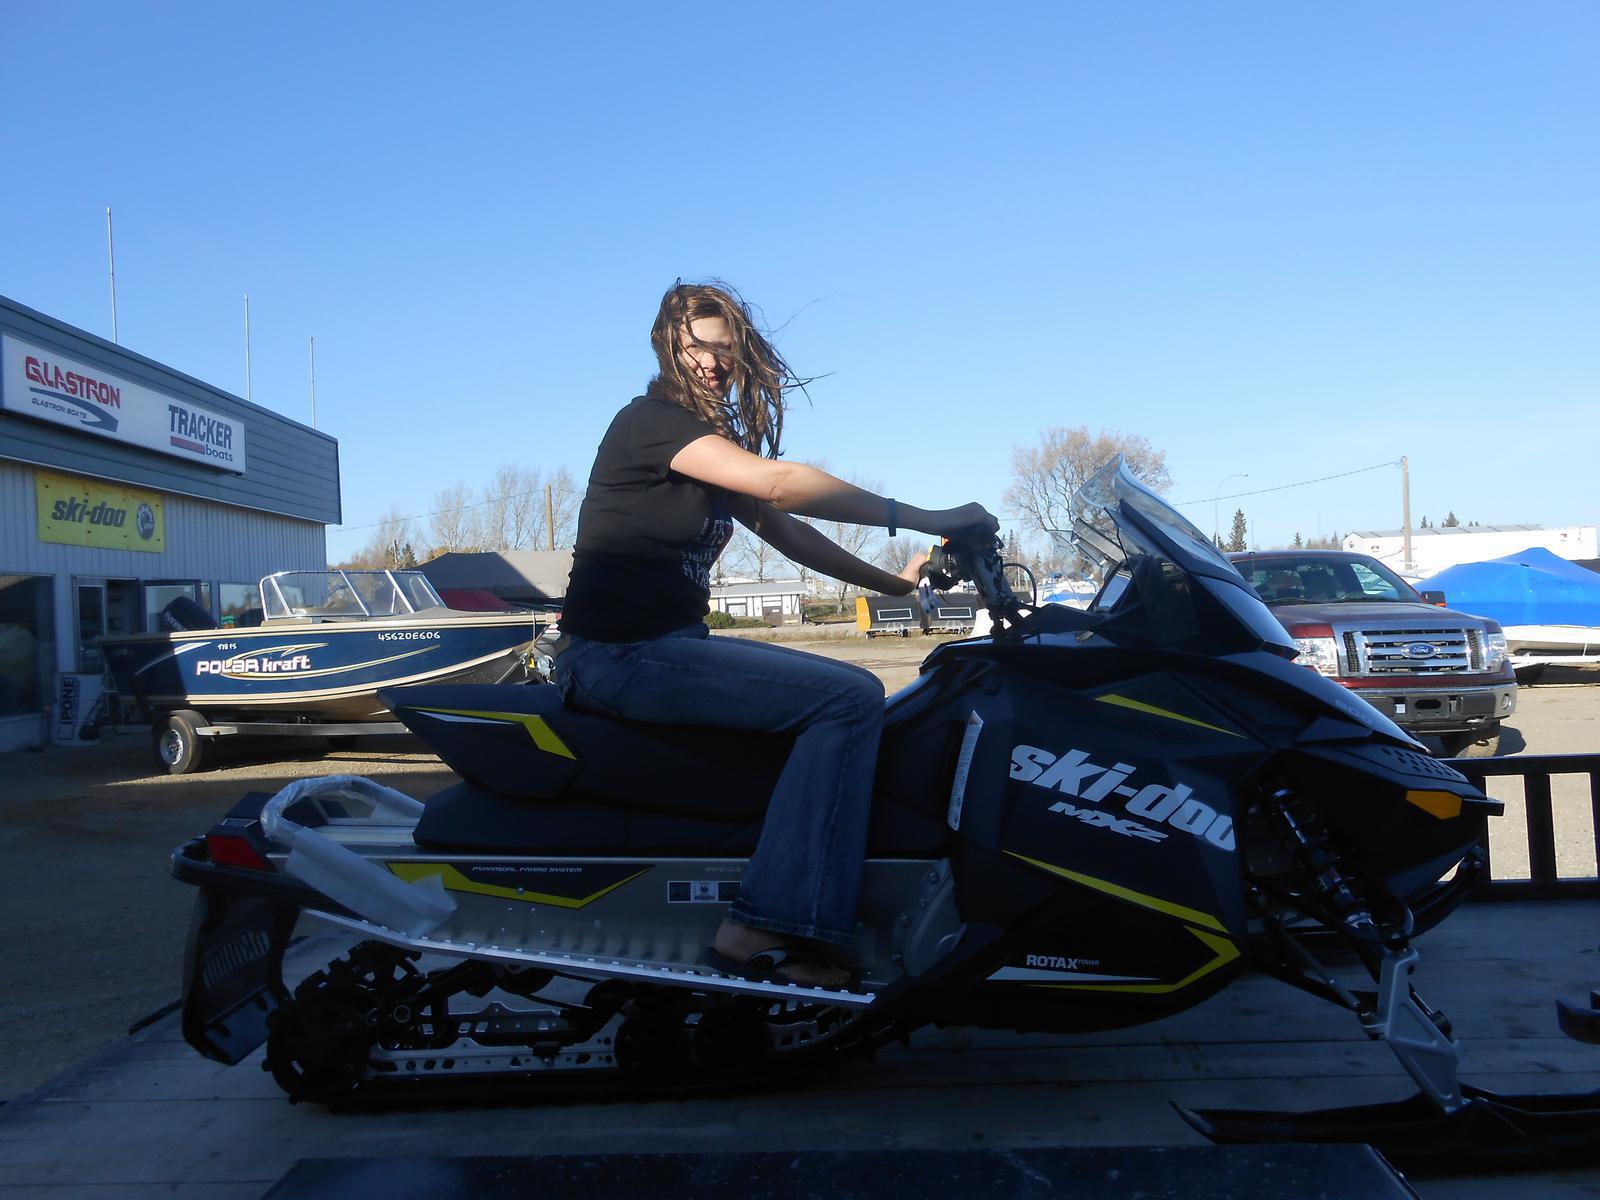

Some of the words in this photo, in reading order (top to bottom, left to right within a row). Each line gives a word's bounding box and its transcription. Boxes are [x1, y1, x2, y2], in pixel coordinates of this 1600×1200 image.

[25, 356, 121, 409] GLASTRON
[32, 397, 66, 413] GLASTRON
[66, 407, 87, 419] BOATS
[168, 404, 232, 450] TRACKER
[205, 444, 233, 462] boats
[51, 497, 127, 527] ski-doo
[261, 655, 311, 673] kraft
[61, 680, 74, 725] IPONE
[1009, 744, 1236, 851] ski-doo
[1026, 954, 1079, 970] ROTAX
